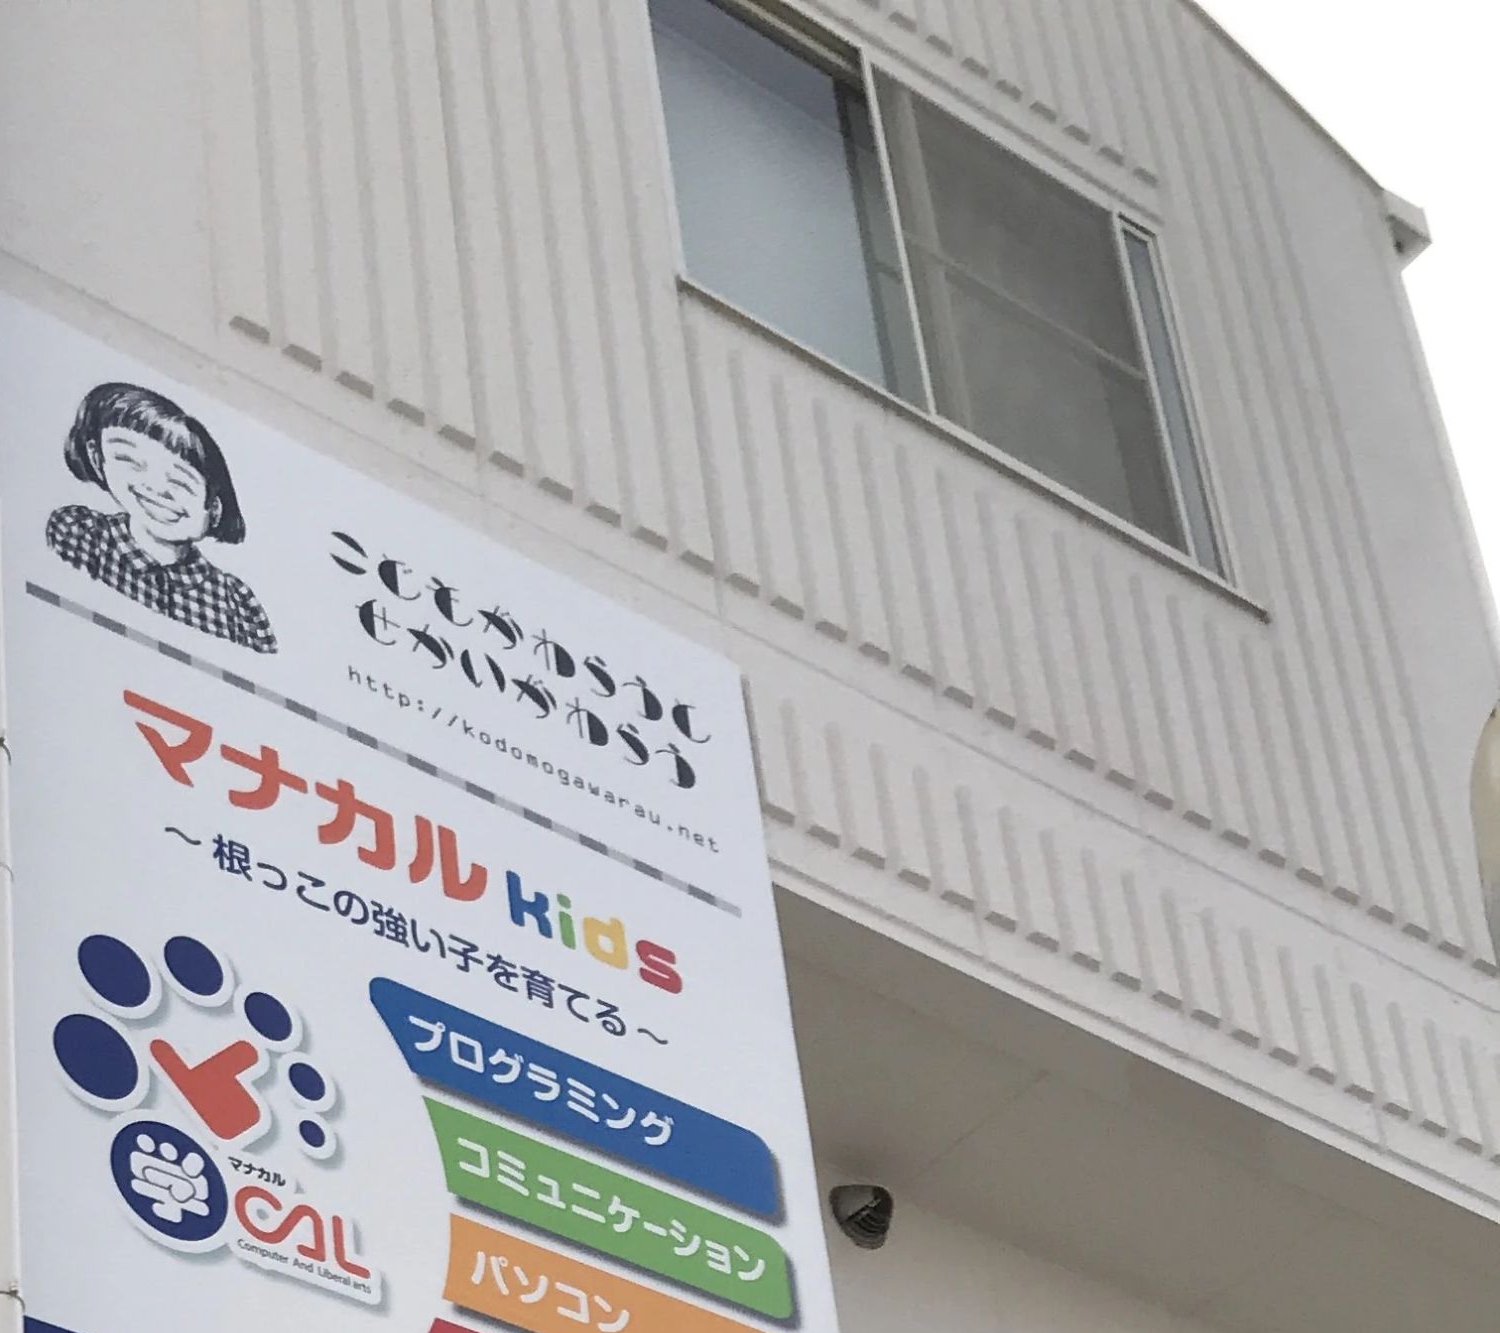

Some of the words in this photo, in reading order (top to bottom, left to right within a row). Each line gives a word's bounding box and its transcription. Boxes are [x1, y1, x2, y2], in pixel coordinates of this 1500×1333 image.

[347, 665, 720, 854] http://kodomogawarau.net
[408, 1014, 675, 1146] プログラミング
[228, 1155, 286, 1187] マナカル
[457, 1137, 766, 1282] コミュニケーション
[237, 1238, 289, 1264] Computer
[293, 1258, 315, 1274] And
[317, 1266, 351, 1287] Liberal
[353, 1280, 373, 1294] arts
[471, 1251, 631, 1333] パソコン
